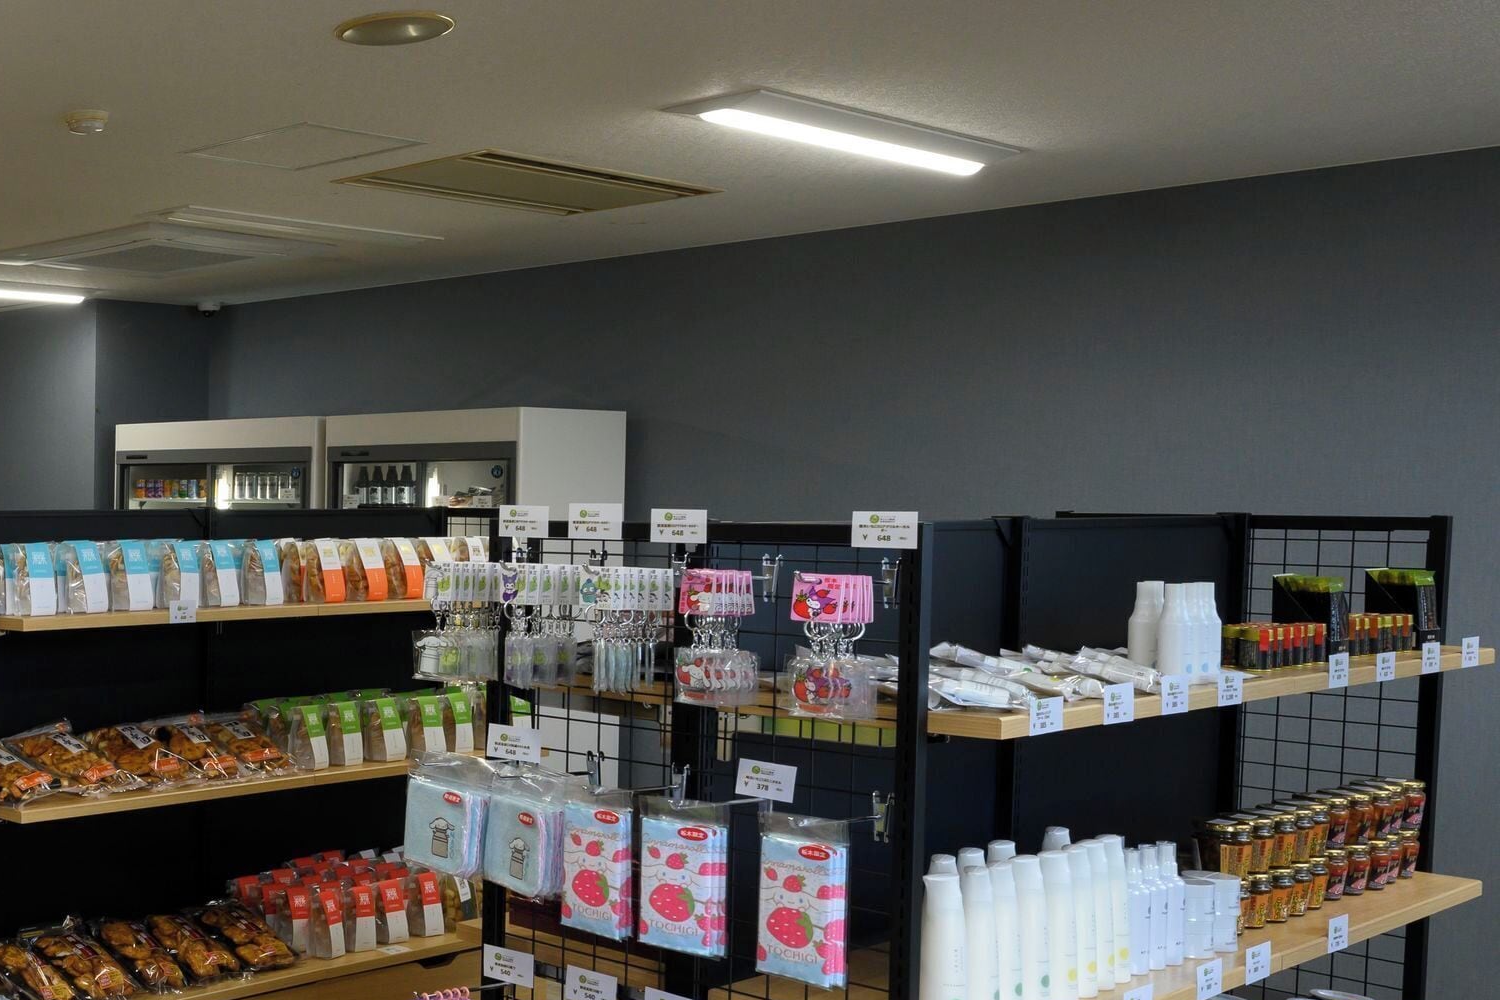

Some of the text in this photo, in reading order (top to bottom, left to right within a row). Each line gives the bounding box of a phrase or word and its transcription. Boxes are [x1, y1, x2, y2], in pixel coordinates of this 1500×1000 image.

[505, 748, 517, 756] 648
[756, 783, 769, 791] 378
[572, 903, 612, 921] TOCHIGI
[649, 919, 698, 936] TOCHIGI
[767, 943, 818, 964] TOCHIGI
